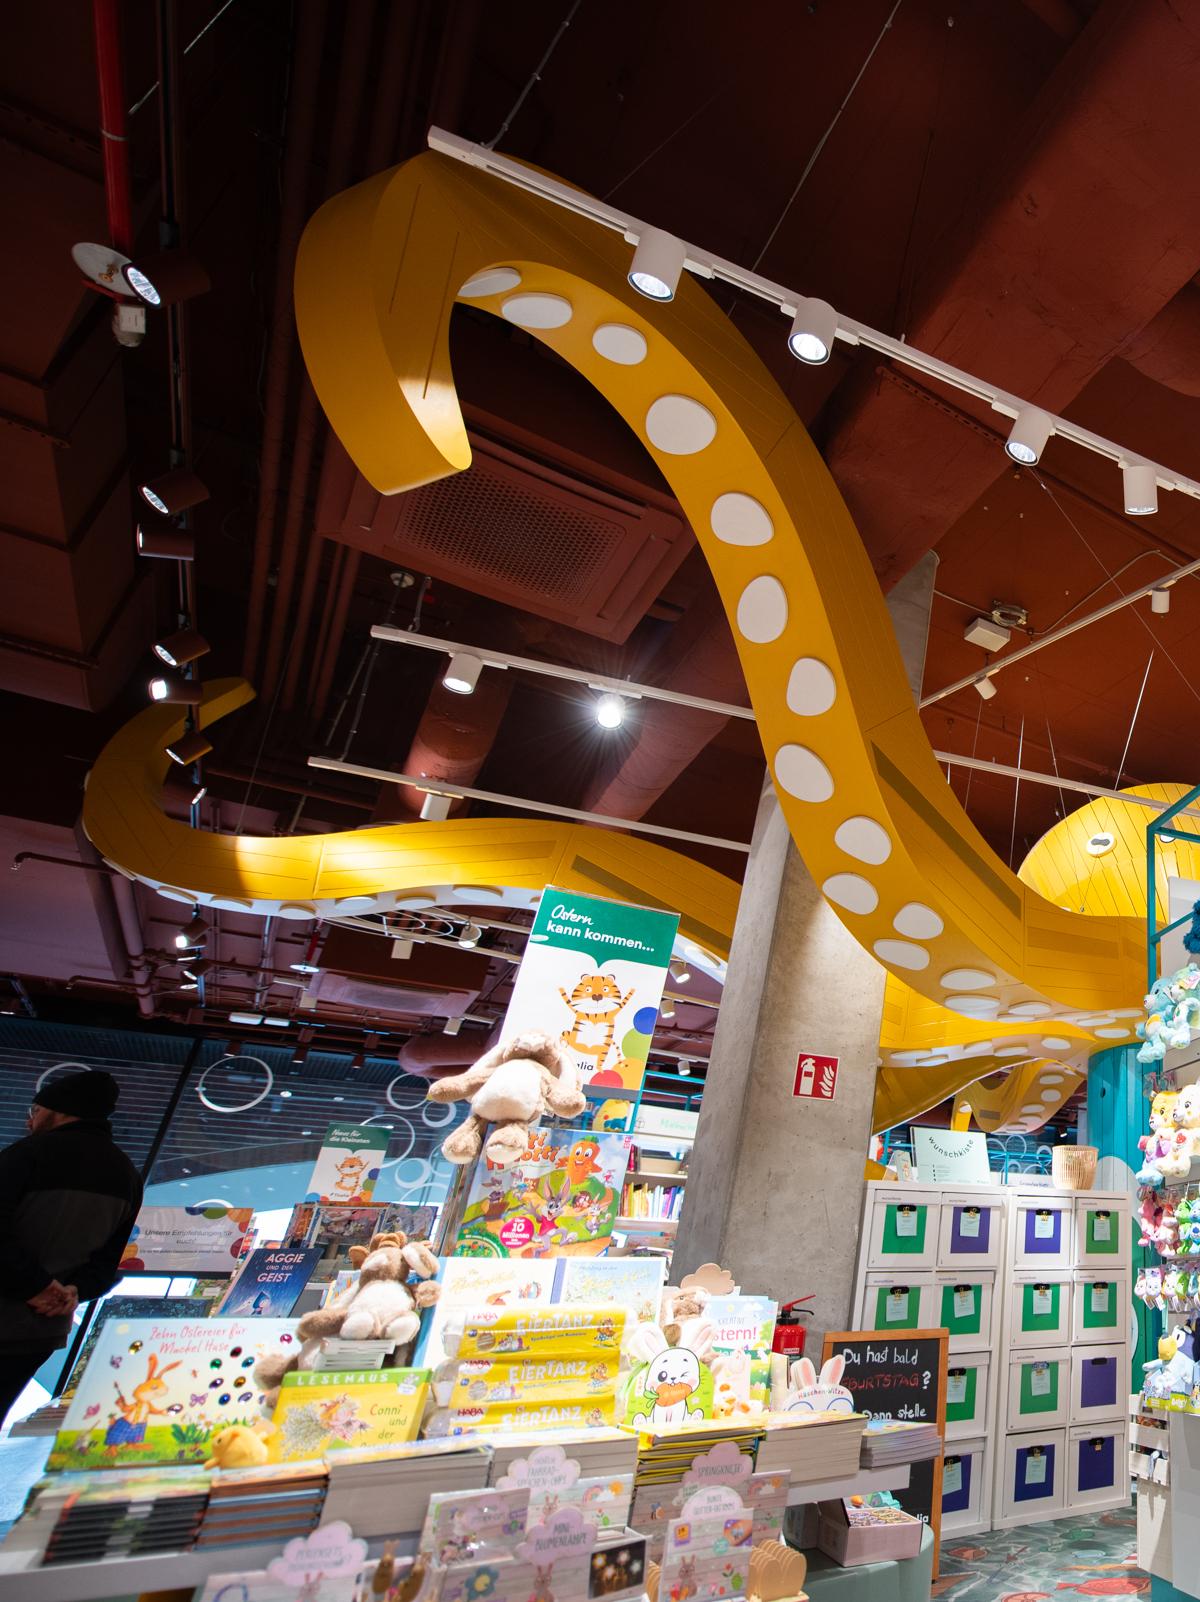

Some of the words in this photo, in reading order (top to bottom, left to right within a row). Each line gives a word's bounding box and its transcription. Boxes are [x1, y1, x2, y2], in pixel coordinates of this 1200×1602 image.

[551, 904, 594, 927] Ostern
[547, 921, 581, 938] kann
[584, 930, 654, 953] kommen...
[512, 1222, 525, 1233] 10
[265, 1253, 306, 1264] AGGIE
[257, 1272, 292, 1283] GEIST
[843, 1348, 860, 1366] Du
[866, 1345, 889, 1364] hast
[893, 1347, 919, 1366] bald
[297, 1373, 390, 1386] LESEMAUS
[370, 1403, 402, 1416] Conni
[897, 1403, 928, 1420] stelle
[389, 1417, 408, 1427] und
[378, 1430, 395, 1440] der
